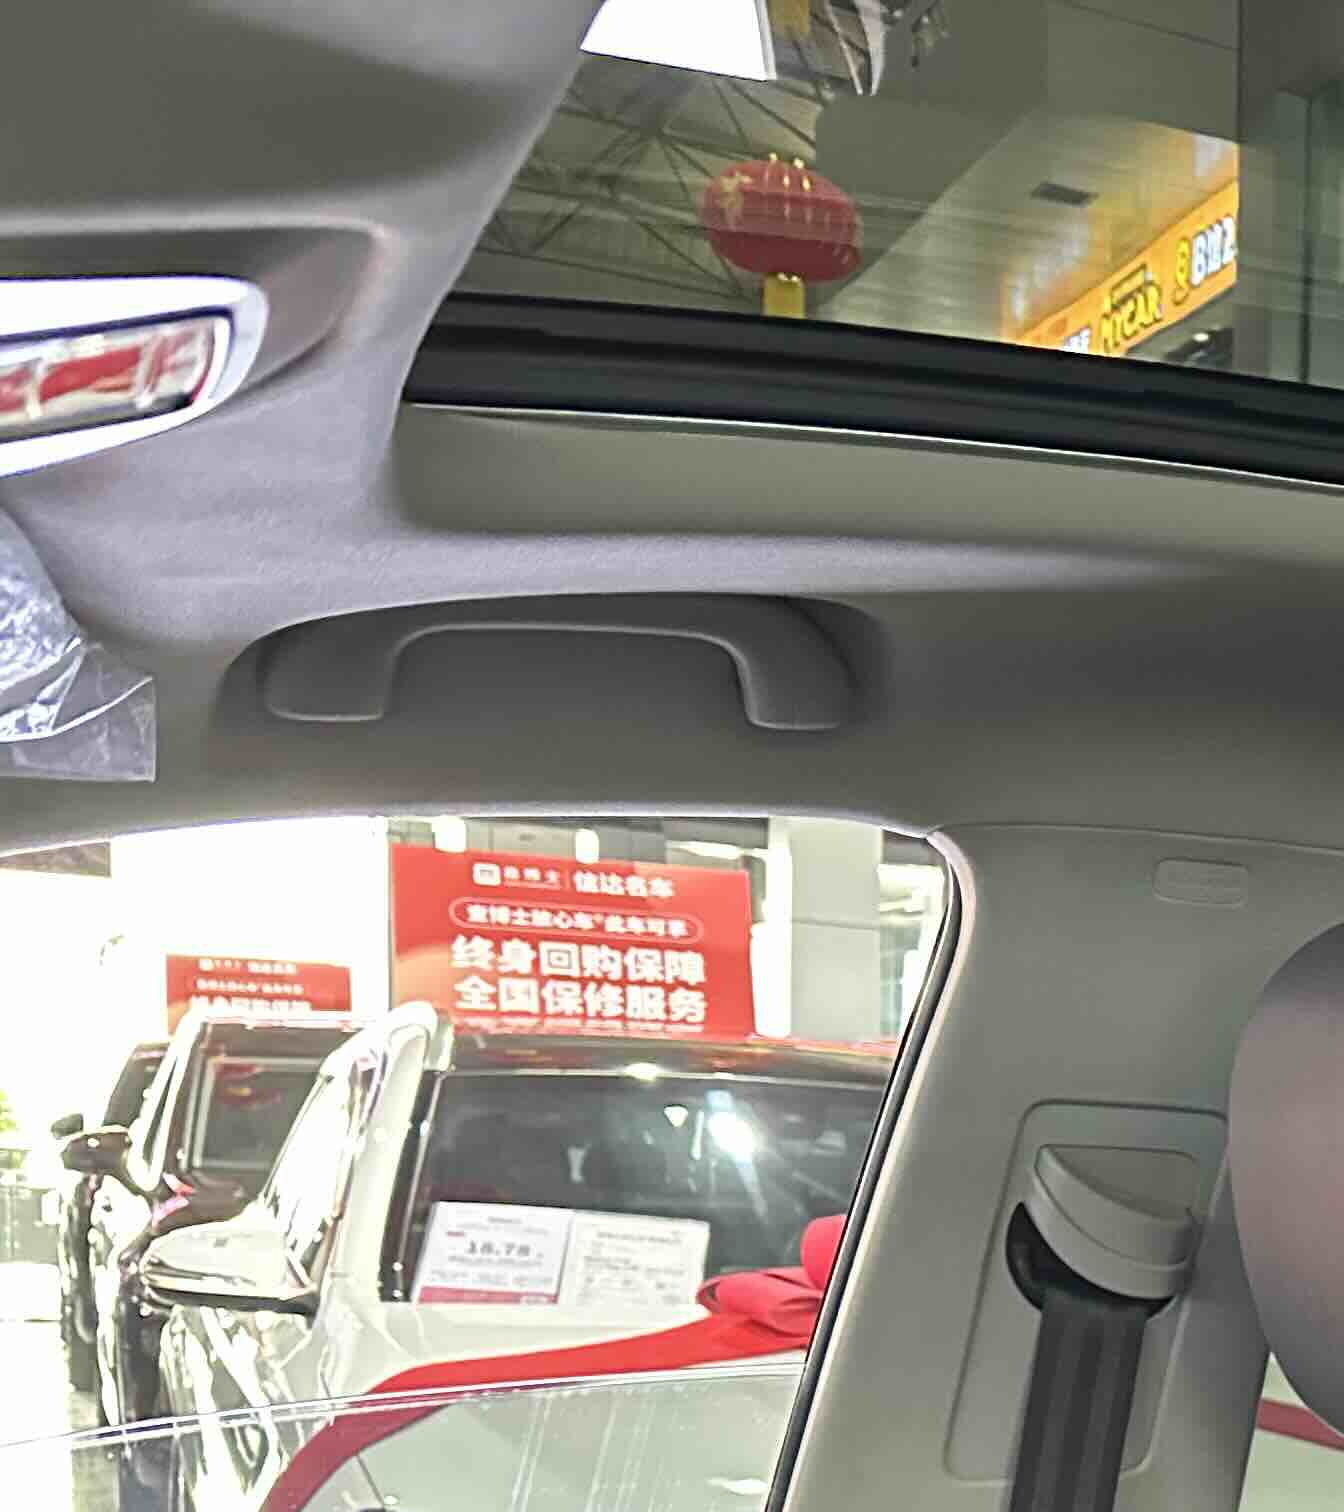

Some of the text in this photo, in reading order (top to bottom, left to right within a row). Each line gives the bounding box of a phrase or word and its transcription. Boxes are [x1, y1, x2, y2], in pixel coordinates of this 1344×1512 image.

[451, 935, 706, 985] 终身回购保障
[453, 975, 708, 1022] 全国保修服务
